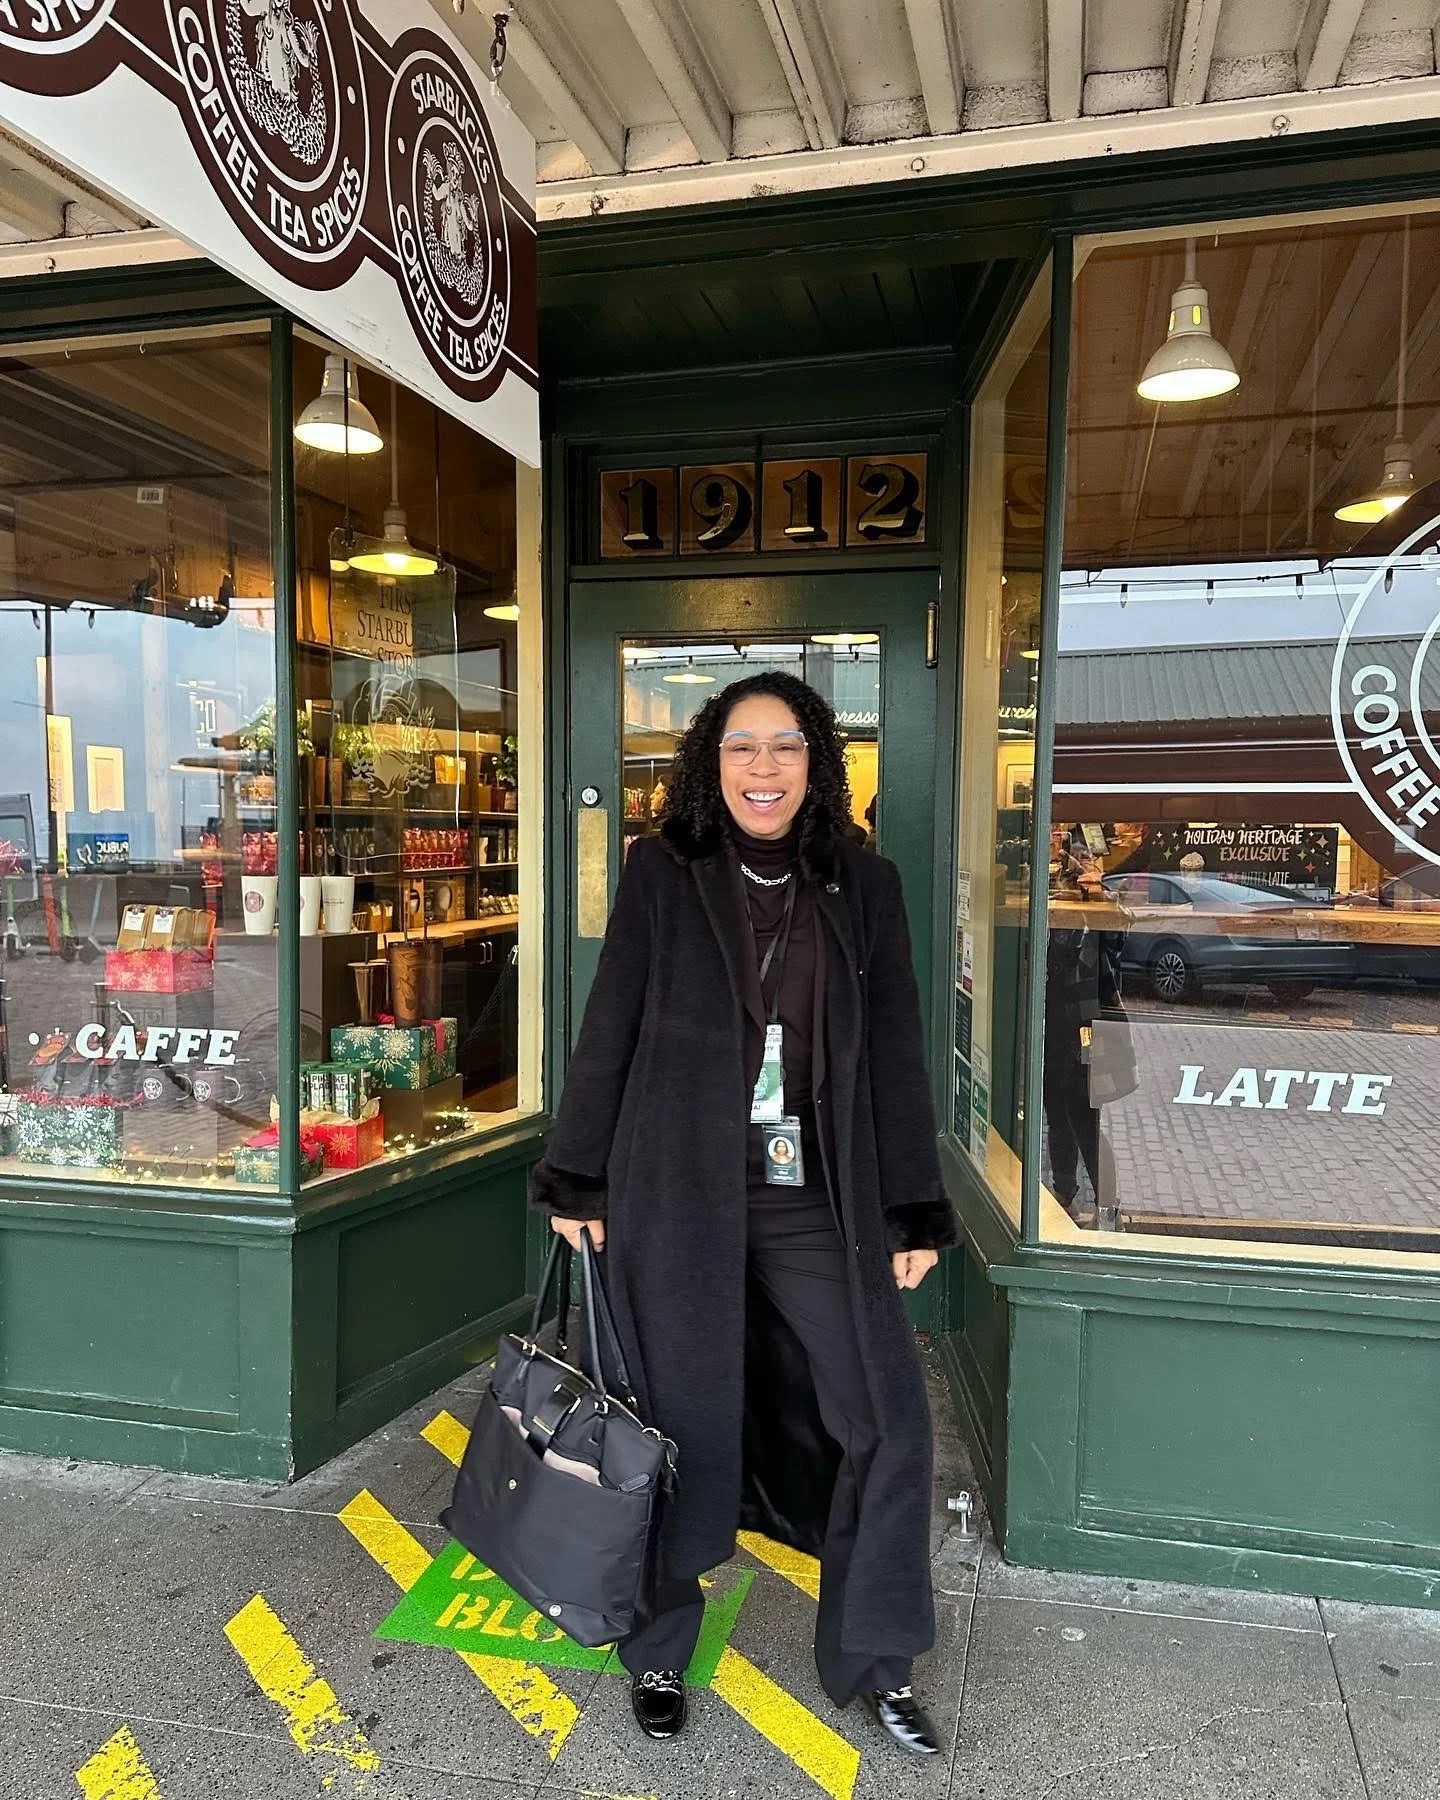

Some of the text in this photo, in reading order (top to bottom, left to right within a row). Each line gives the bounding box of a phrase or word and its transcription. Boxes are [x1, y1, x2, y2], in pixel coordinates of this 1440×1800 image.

[178, 6, 361, 247] COFFEE TEA SPICES
[411, 72, 490, 184] STARBUCKS
[396, 203, 506, 370] COFFEE TEA SPICES
[618, 463, 924, 549] 1912
[1351, 664, 1440, 829] COFFEE
[1184, 829, 1304, 845] HOLIDAY HERITAGE
[1219, 846, 1291, 862] EXCLUSIVE
[1268, 871, 1290, 887] LATTE
[75, 1023, 240, 1065] CAFFE
[1172, 1064, 1393, 1116] LATTE
[435, 1593, 567, 1642] BLO
